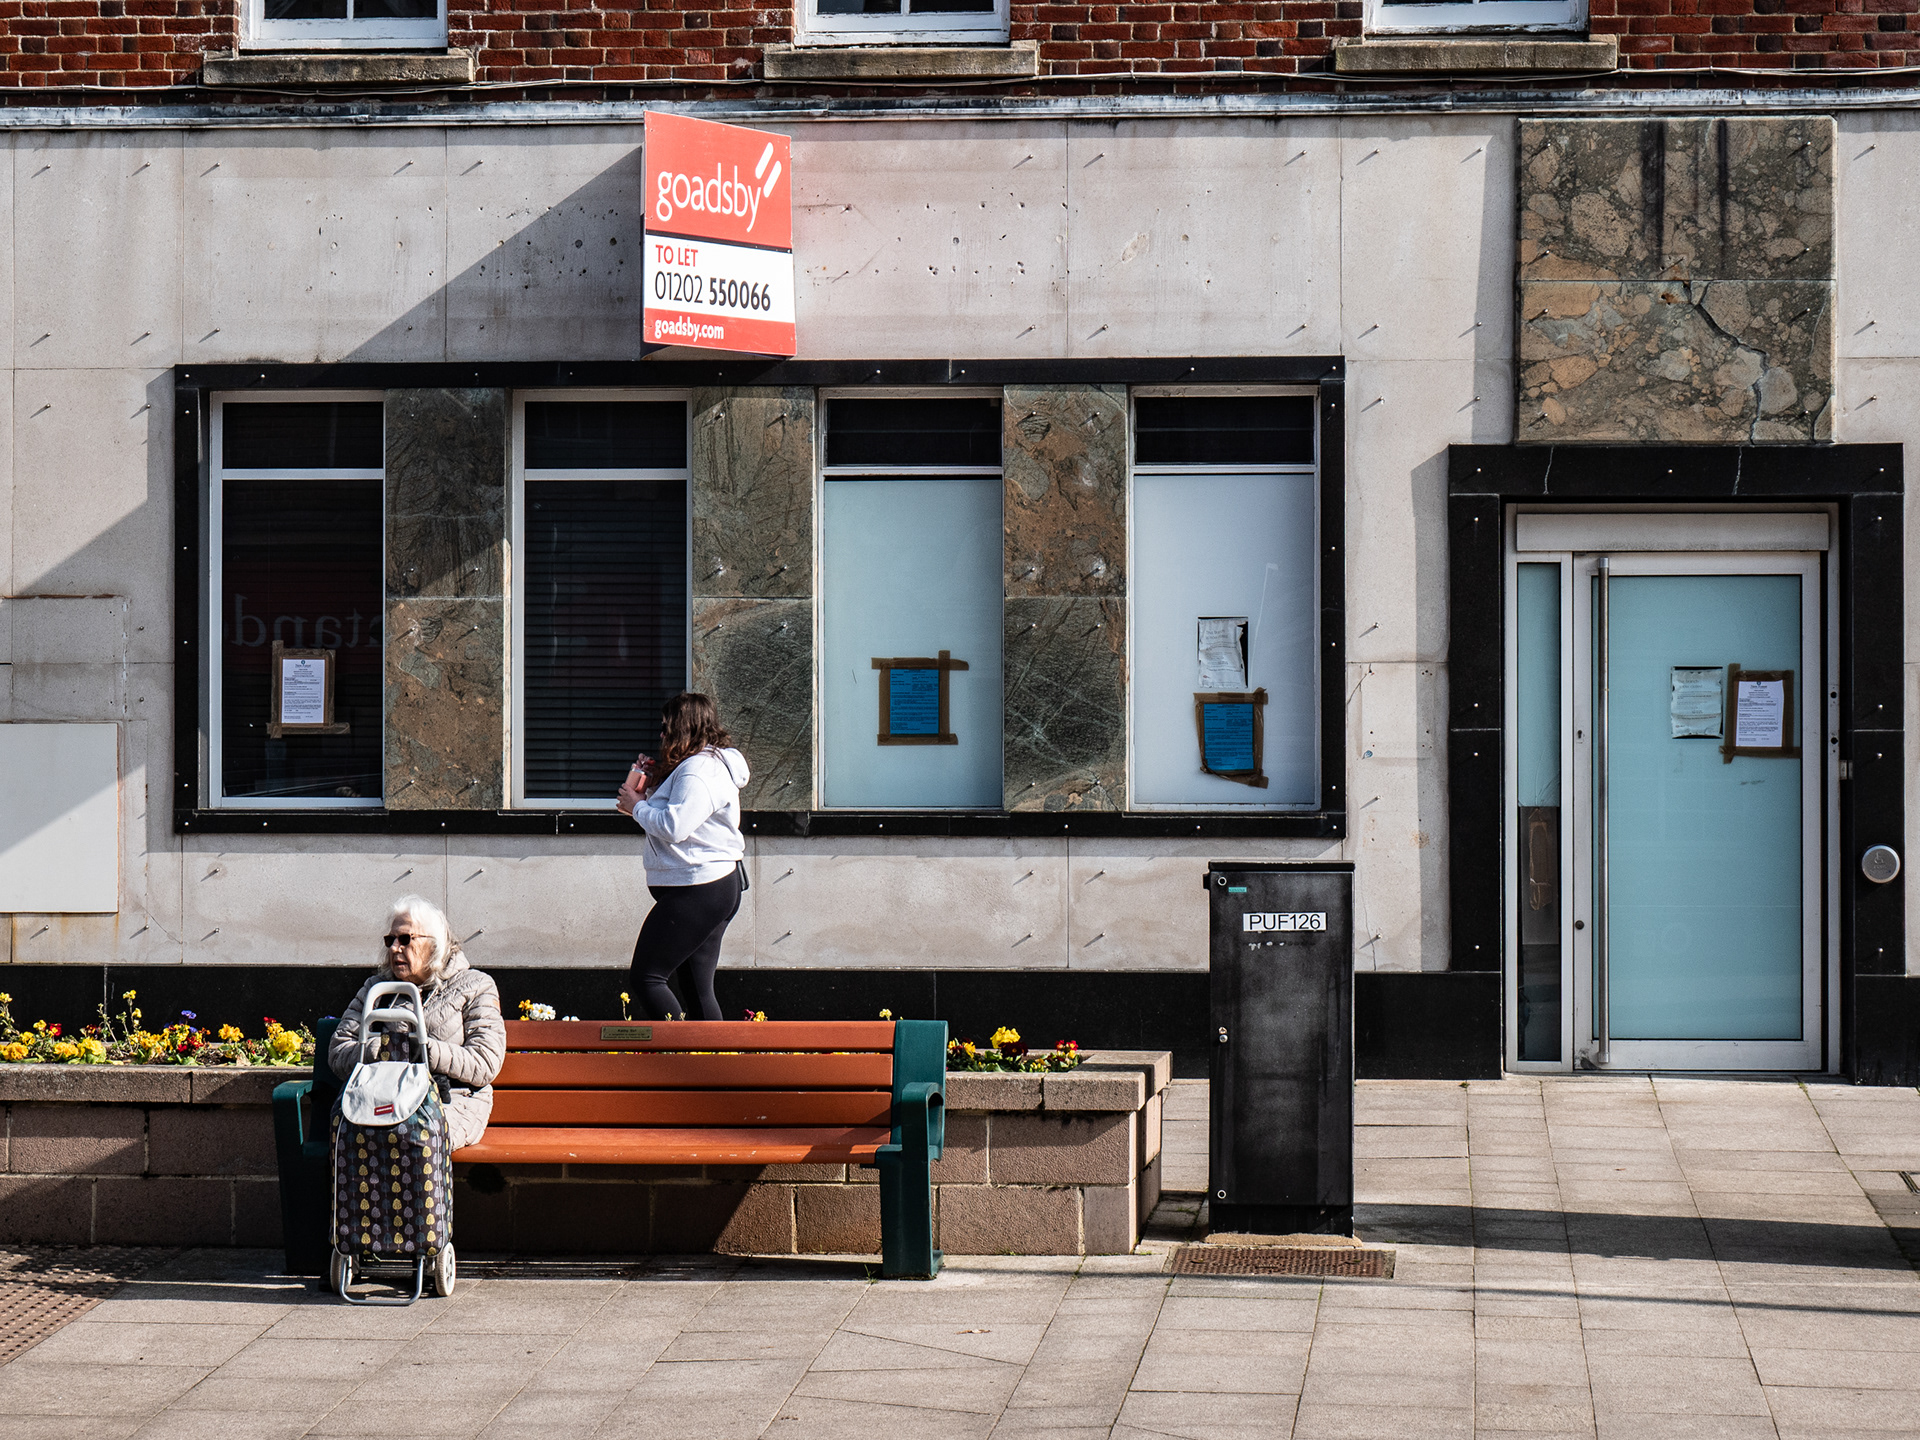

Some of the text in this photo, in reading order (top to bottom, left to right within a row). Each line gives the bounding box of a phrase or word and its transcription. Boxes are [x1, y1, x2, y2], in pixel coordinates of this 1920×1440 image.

[656, 162, 762, 233] goadsby
[655, 244, 699, 267] TO LET
[655, 270, 771, 311] 01202 550066
[654, 316, 724, 343] goadsby.com
[1249, 913, 1321, 930] PUF126
